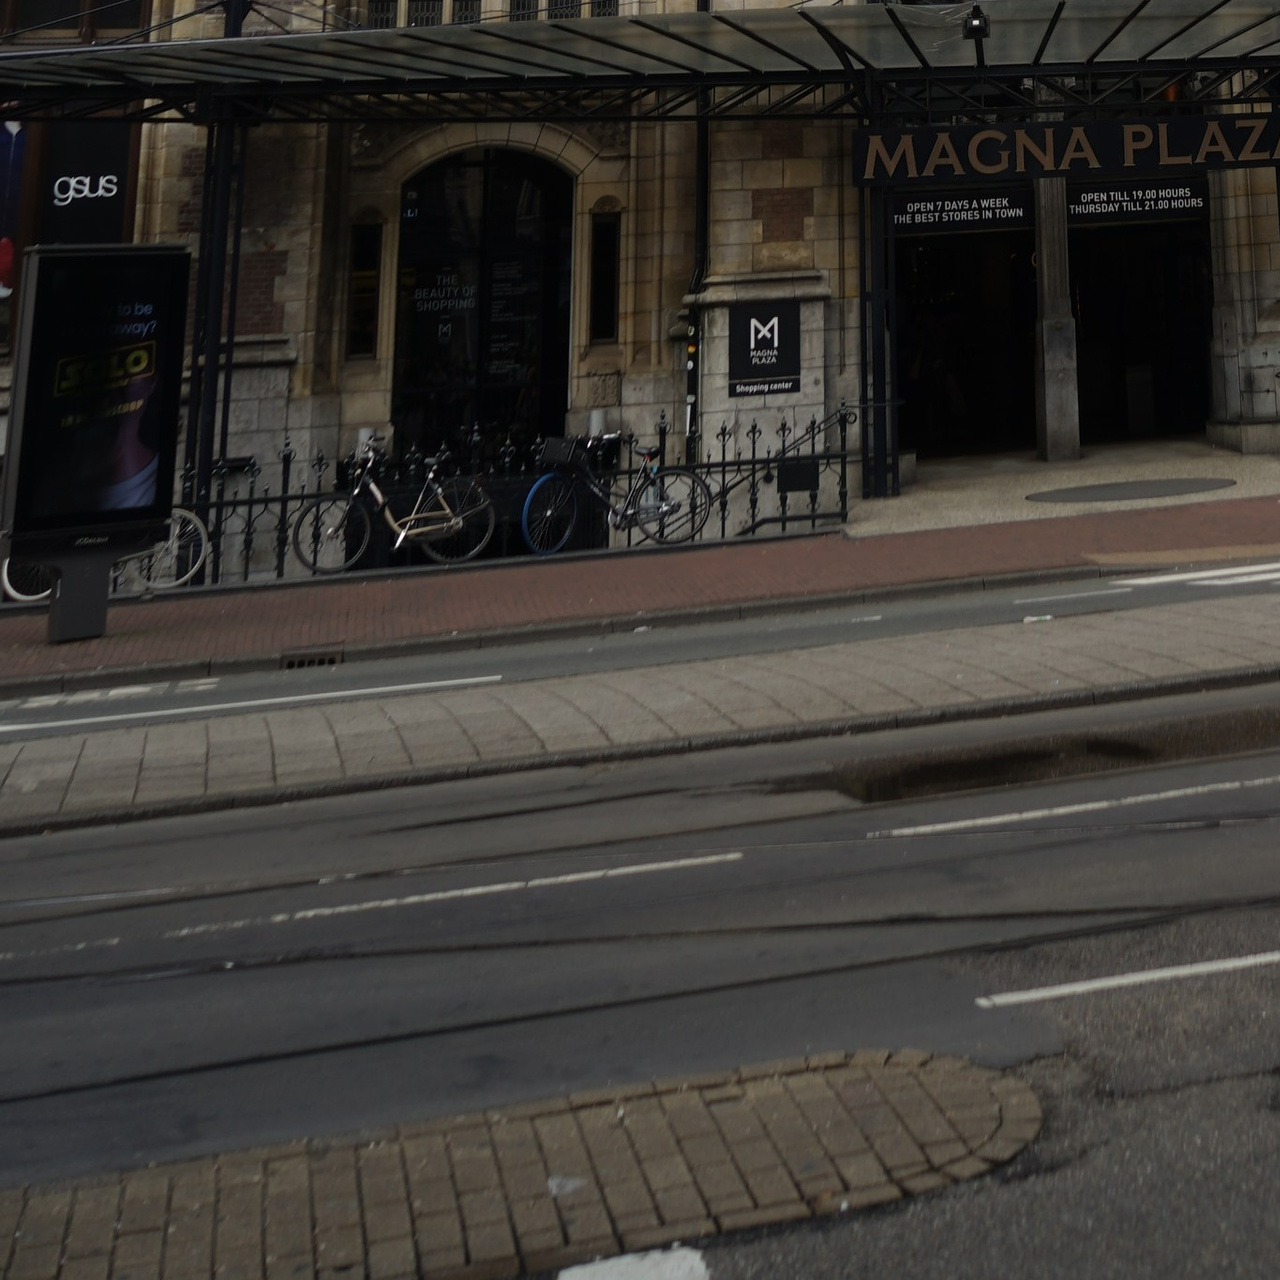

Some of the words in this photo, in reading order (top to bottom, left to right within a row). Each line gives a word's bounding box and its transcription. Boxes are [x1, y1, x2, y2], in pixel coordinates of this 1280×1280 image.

[862, 126, 1101, 180] MAGNA
[52, 174, 118, 207] gsus
[1081, 192, 1107, 202] OPEN
[1109, 191, 1130, 201] TILL
[1132, 189, 1157, 200] 19.00
[1159, 187, 1191, 198] HOURS
[907, 202, 934, 212] OPEN
[936, 201, 942, 211] 7
[944, 200, 969, 210] DAYS
[971, 199, 979, 209] A
[980, 197, 1009, 208] WEEK
[1069, 202, 1120, 214] THURSDAY
[1122, 201, 1143, 212] TILL
[1144, 199, 1169, 210] 21.00
[1171, 198, 1203, 209] HOURS
[893, 214, 912, 224] THE
[914, 212, 940, 223] BEST
[942, 210, 980, 221] STORES
[982, 209, 993, 219] IN
[994, 208, 1023, 219] TOWN
[435, 274, 459, 286] THE
[414, 287, 460, 300] BEAUTY
[462, 285, 479, 298] OF
[133, 300, 155, 316] be
[415, 298, 477, 312] SHOPPING
[750, 349, 778, 358] MAGNA
[751, 356, 777, 366] PLAZA
[735, 383, 769, 395] Shopping
[769, 381, 793, 390] center
